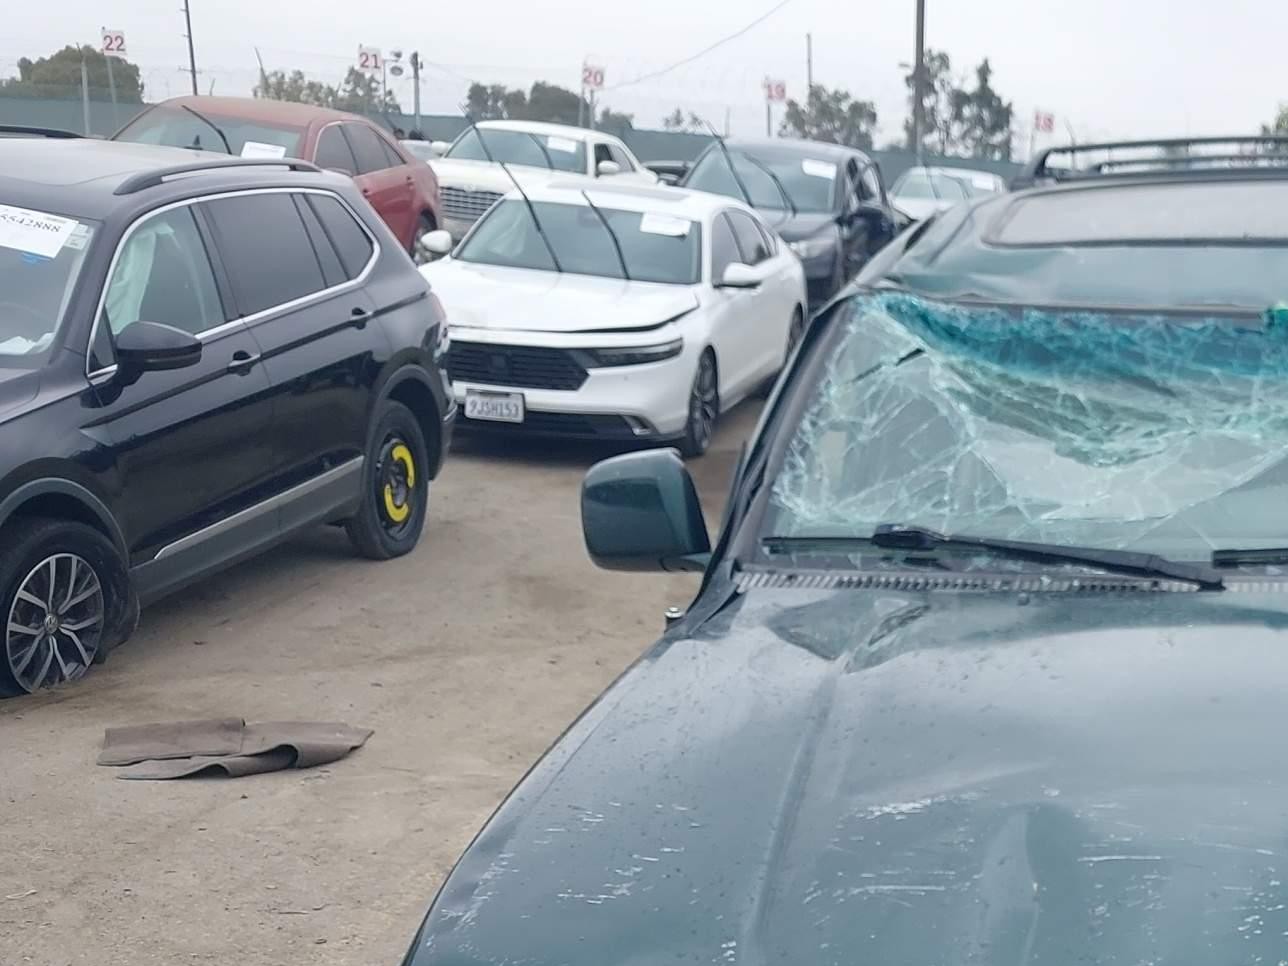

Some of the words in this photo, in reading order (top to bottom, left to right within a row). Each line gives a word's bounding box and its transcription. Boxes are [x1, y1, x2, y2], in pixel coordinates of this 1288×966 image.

[103, 35, 126, 52] 22
[359, 52, 382, 69] 21
[582, 67, 605, 86] 20
[767, 84, 786, 100] 19
